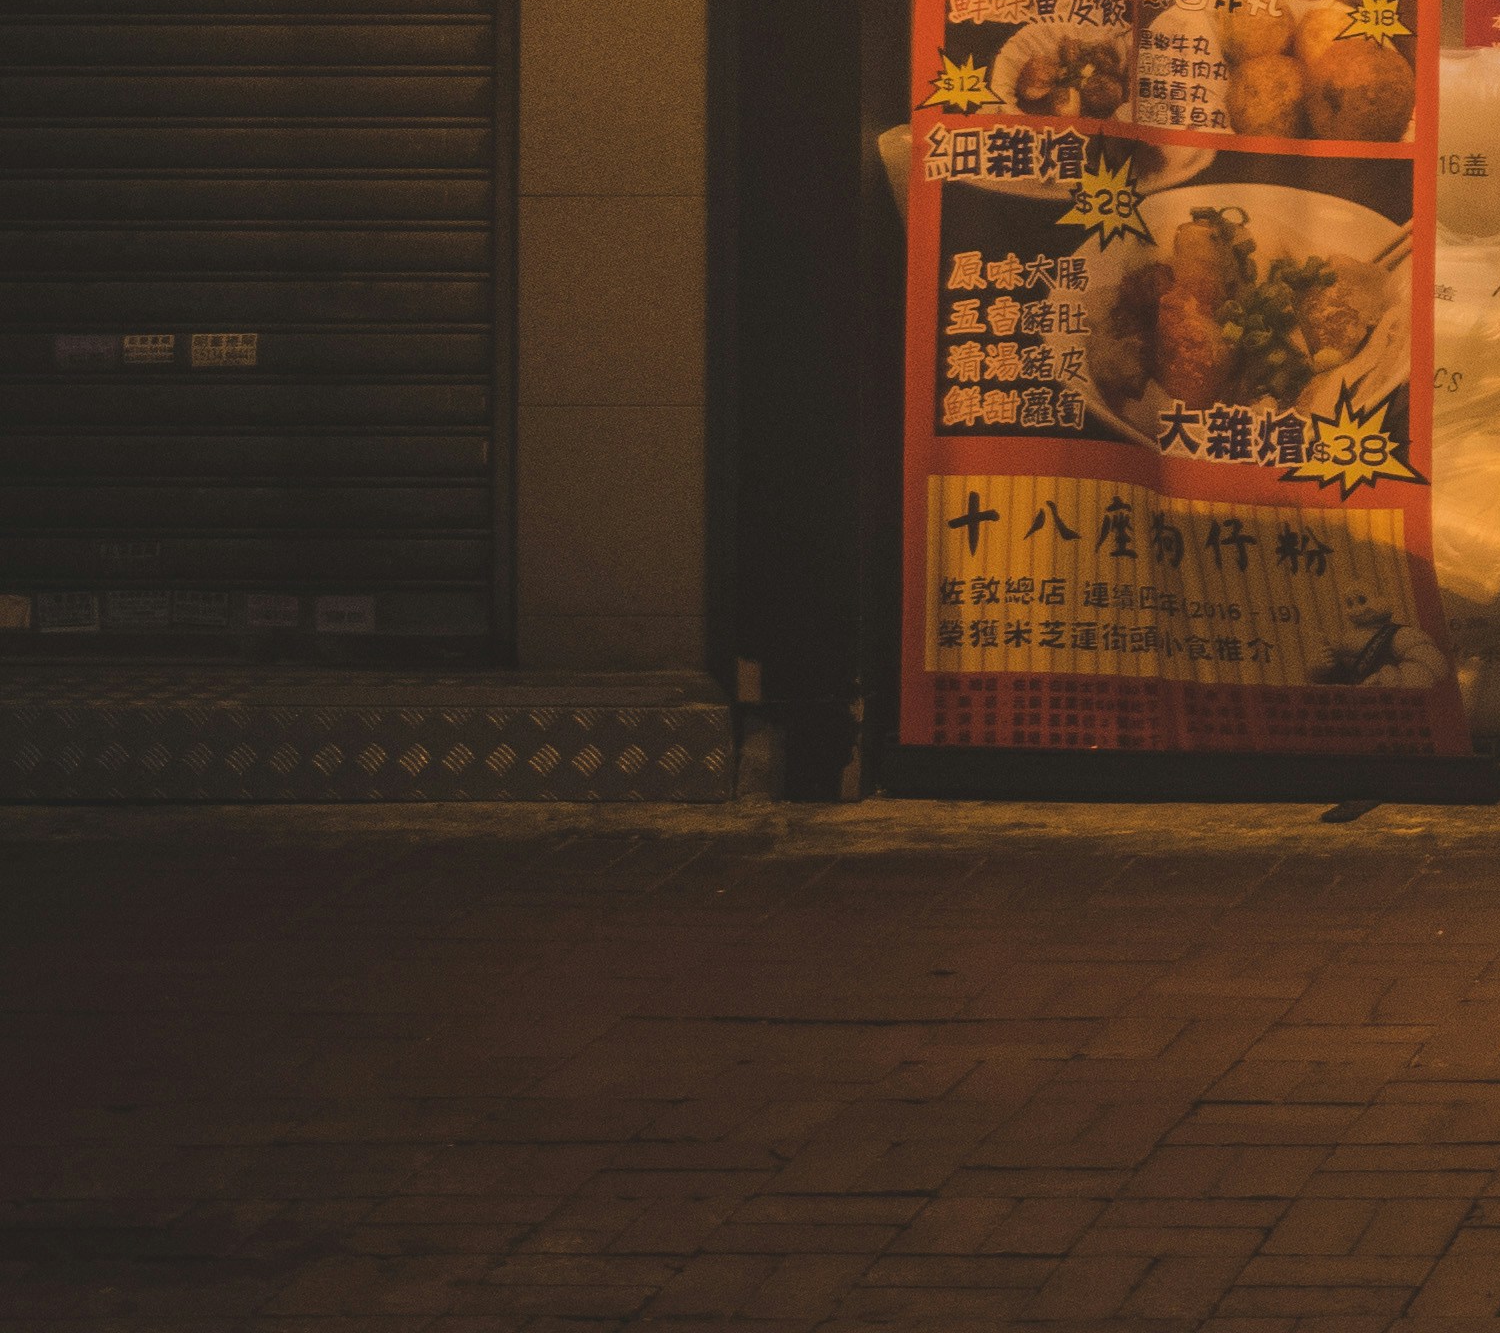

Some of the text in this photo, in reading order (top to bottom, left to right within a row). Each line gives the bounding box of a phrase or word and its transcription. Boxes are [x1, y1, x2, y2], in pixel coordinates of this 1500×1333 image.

[1361, 8, 1397, 27] $18
[942, 74, 982, 94] $12
[926, 124, 1087, 182] 細雜燴
[1073, 189, 1132, 219] $28
[948, 251, 1090, 293] 原味大腸
[945, 299, 1090, 336] 五香豬肚
[946, 344, 1089, 383] 清湯豬皮
[942, 388, 1085, 431] 鮮甜蘿蔔
[1159, 401, 1307, 468] 大雜燴
[1312, 434, 1390, 468] $38
[946, 489, 1335, 578] 十八座狗仔粉
[939, 576, 1067, 608] 佐敦總店
